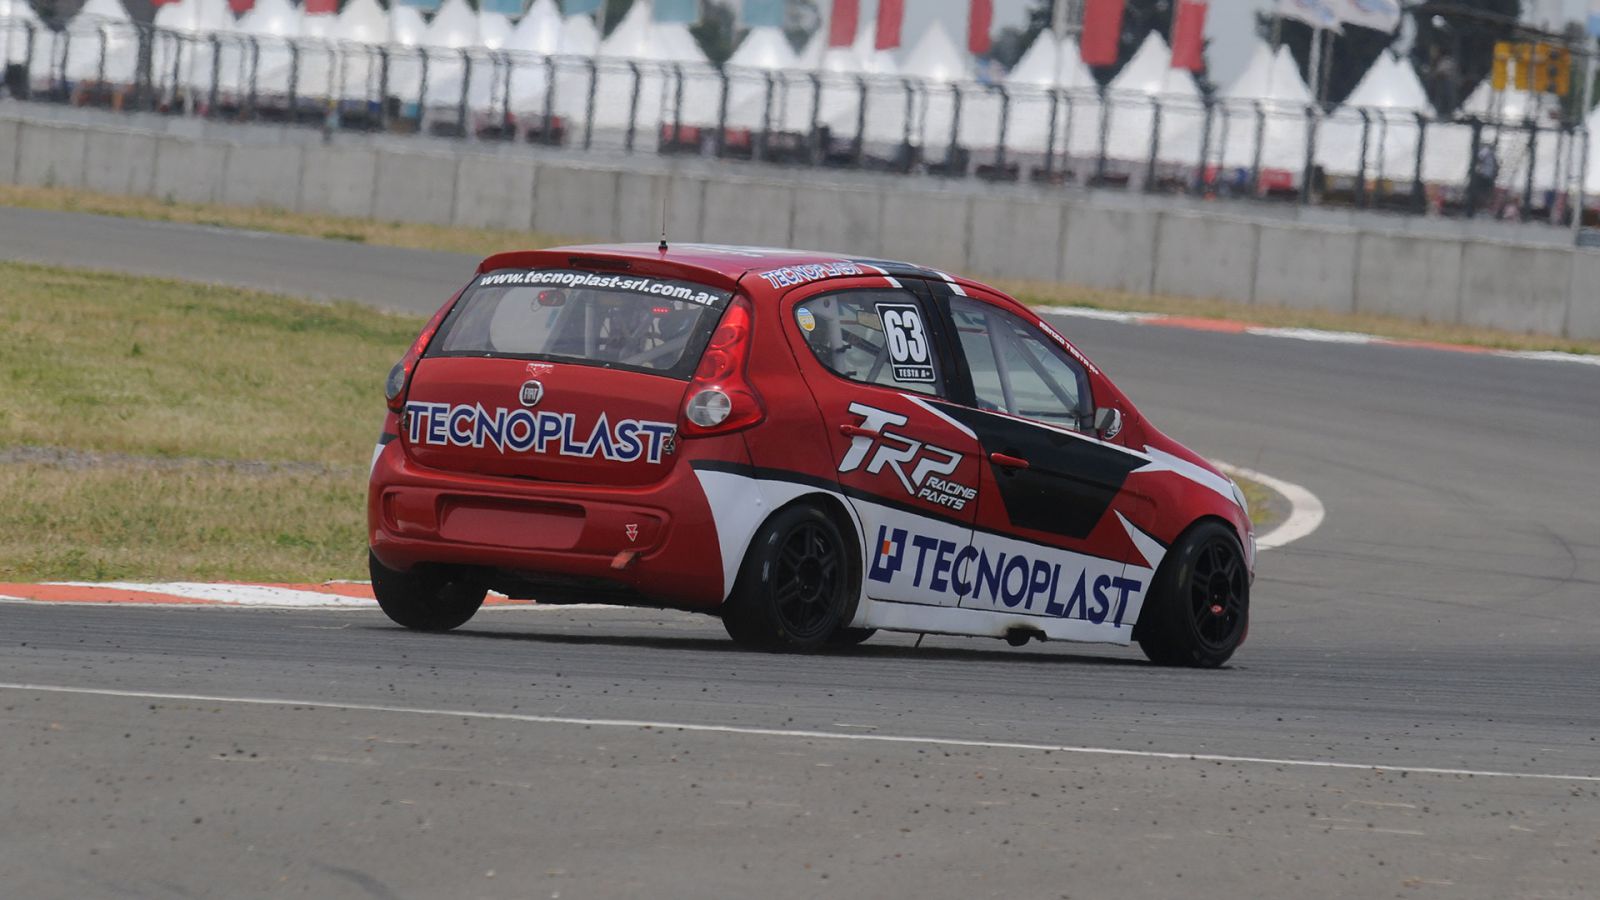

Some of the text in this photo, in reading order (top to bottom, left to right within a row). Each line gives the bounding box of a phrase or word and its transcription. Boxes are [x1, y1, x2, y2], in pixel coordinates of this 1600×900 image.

[480, 271, 719, 306] www.tecnoplast-srl.com.ar
[759, 263, 863, 289] TECNOPLAST
[884, 310, 927, 362] 63
[899, 369, 919, 377] TESTA
[406, 401, 677, 464] TECNOPLAST
[838, 402, 963, 495] TRP
[918, 488, 966, 510] PARTS
[926, 477, 977, 499] RACING
[912, 534, 1142, 628] TECNOPLAST
